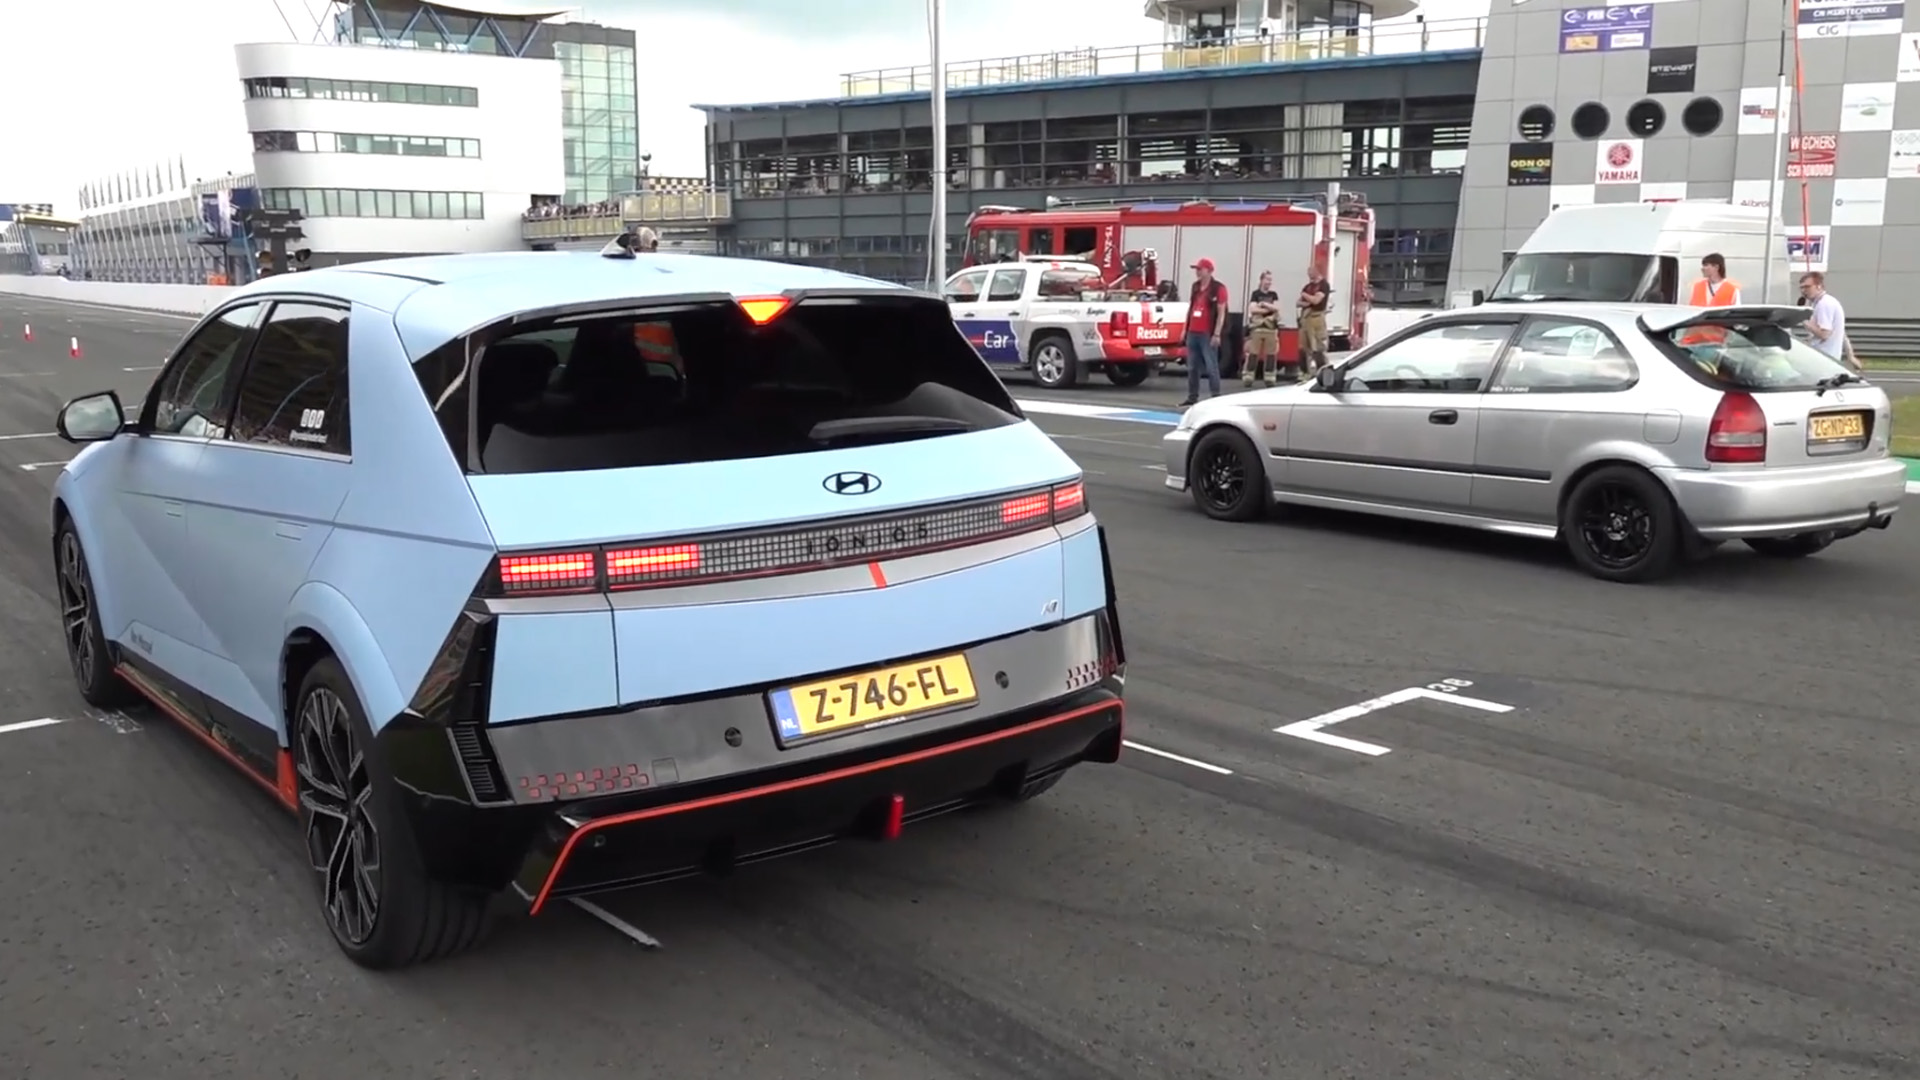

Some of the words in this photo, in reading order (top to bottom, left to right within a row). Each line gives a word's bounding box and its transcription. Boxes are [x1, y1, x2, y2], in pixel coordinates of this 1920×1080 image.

[1816, 25, 1839, 36] CIG
[1790, 135, 1836, 151] WGCHERS
[1598, 170, 1639, 182] YAMAHA
[1787, 242, 1820, 256] PM
[984, 330, 1009, 348] Car
[1136, 326, 1169, 340] Rescue
[808, 527, 906, 555] IONIQ
[917, 523, 928, 539] 5
[809, 664, 959, 724] Z-746-FL
[781, 717, 798, 730] NL
